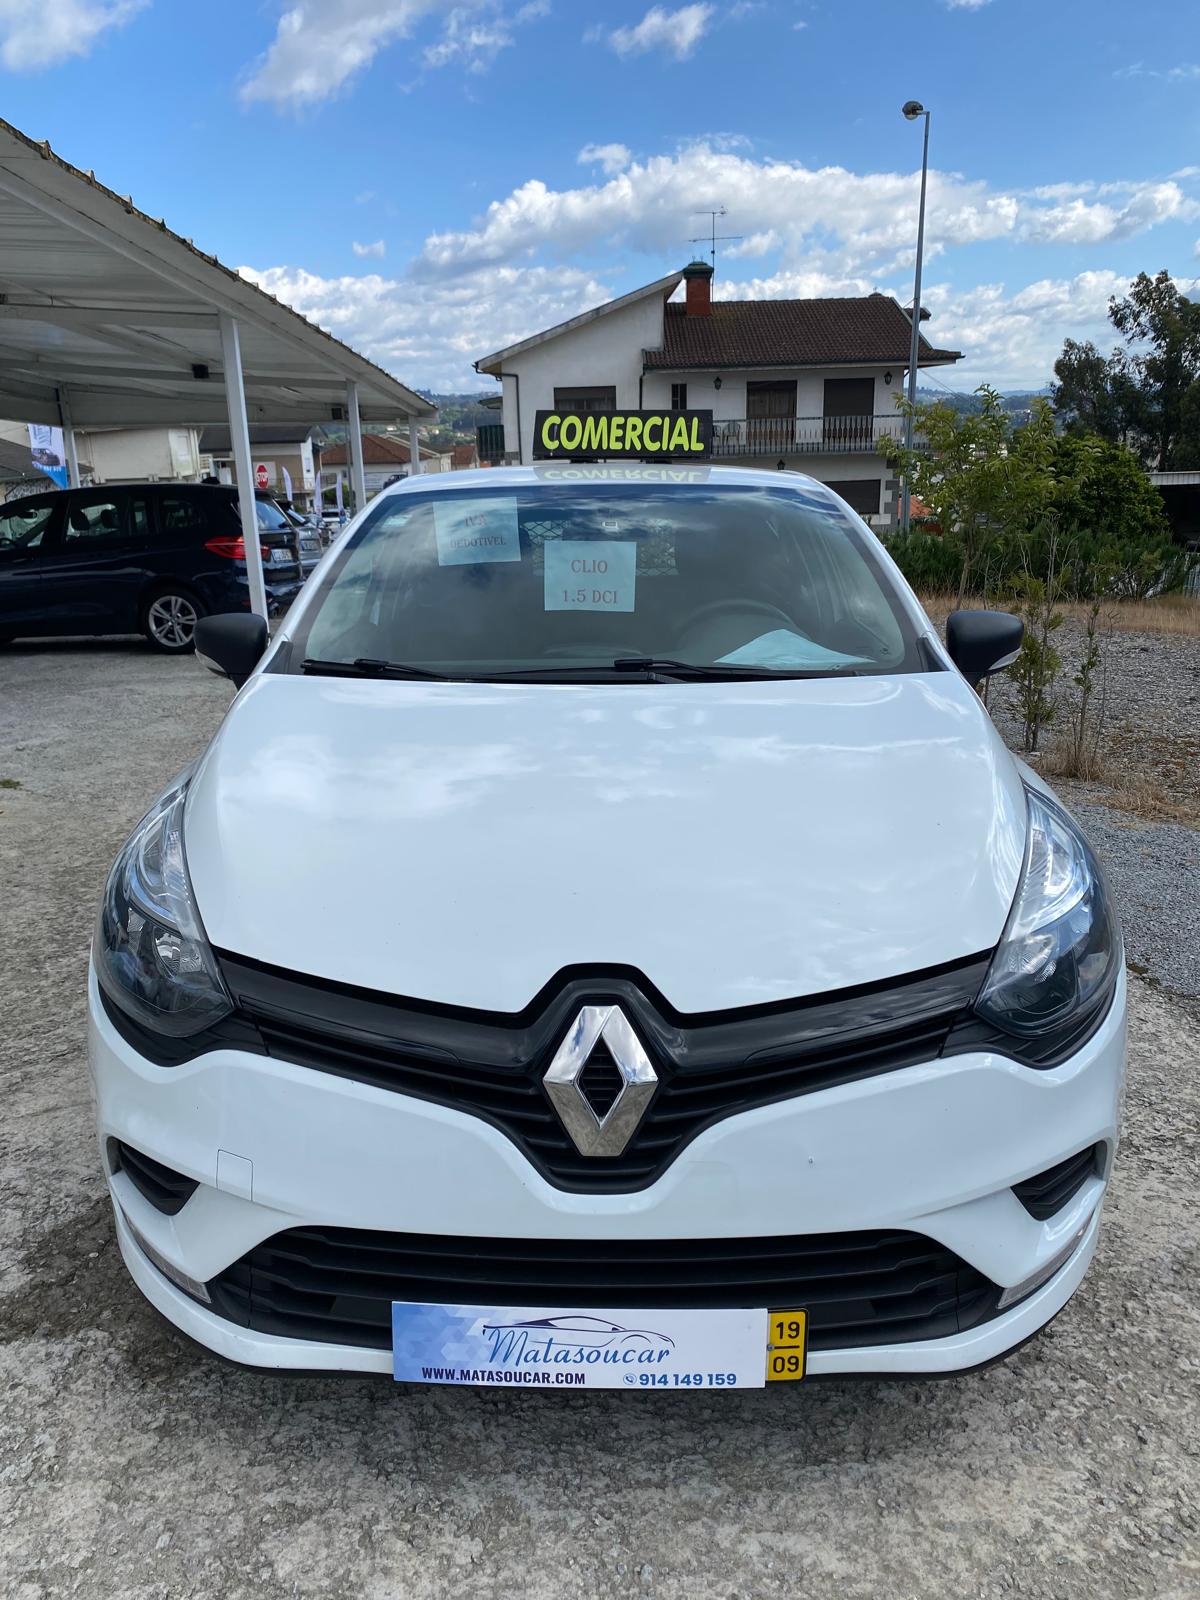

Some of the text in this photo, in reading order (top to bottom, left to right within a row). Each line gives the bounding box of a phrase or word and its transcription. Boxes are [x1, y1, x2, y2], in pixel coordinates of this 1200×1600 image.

[542, 415, 705, 452] COMERCIAL
[571, 559, 608, 574] CLIO
[563, 589, 618, 604] 1.5 DCI
[775, 1321, 800, 1340] 19
[488, 1328, 670, 1367] Matasoucar
[772, 1355, 800, 1374] 09
[422, 1366, 586, 1385] WWW.MATASOUCAR.COM
[639, 1373, 737, 1386] 914 149 159
